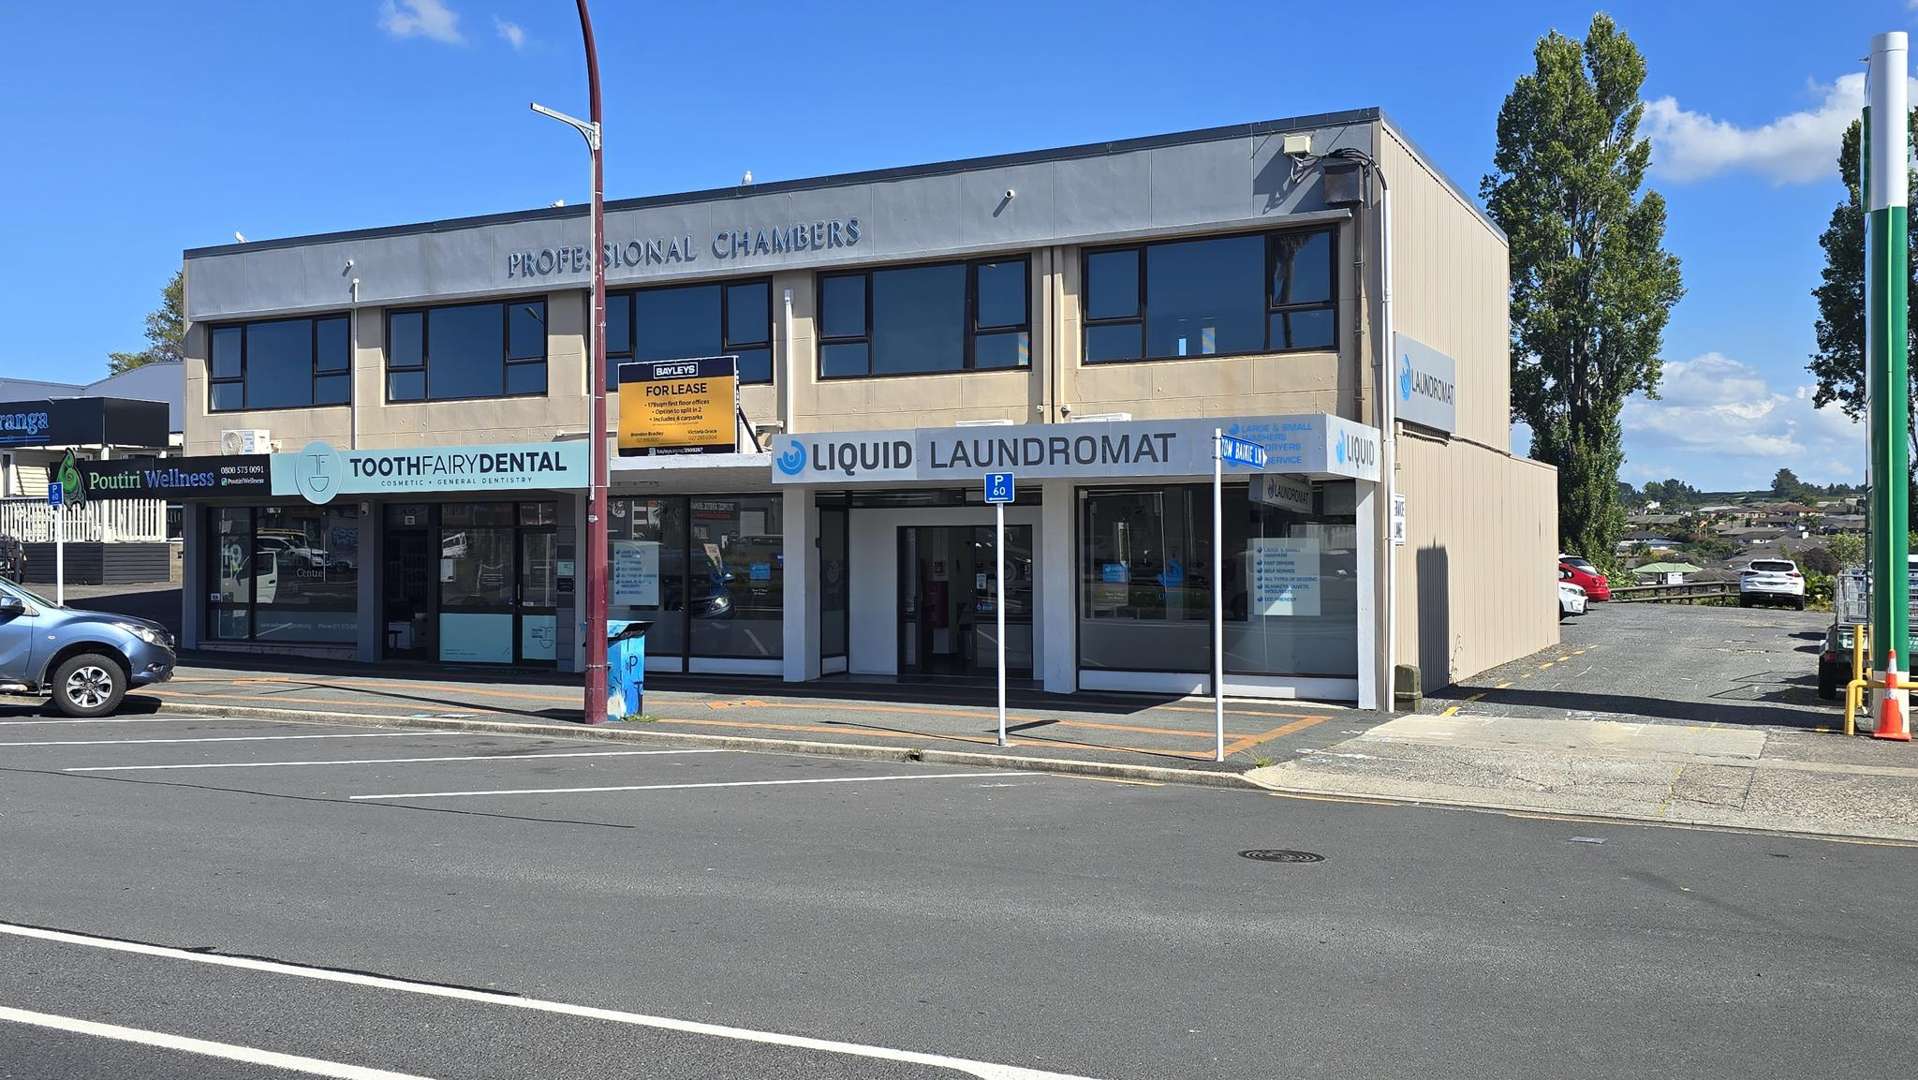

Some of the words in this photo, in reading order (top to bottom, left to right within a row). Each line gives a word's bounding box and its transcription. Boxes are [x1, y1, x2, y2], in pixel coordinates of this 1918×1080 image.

[712, 217, 863, 260] CHAMBERS
[655, 365, 696, 376] BAYLEYS
[646, 385, 669, 397] FOR
[671, 383, 708, 395] LEASE
[1411, 369, 1454, 406] LAUNDROMAT
[812, 440, 912, 476] LIQUID
[930, 432, 1176, 469] LAUNDROMAT
[1346, 434, 1375, 469] LIQUID
[220, 466, 236, 474] 0800
[90, 470, 141, 490] Poutiri
[144, 468, 215, 488] Wellness
[482, 477, 532, 485] DENTISTRY
[994, 475, 1004, 487] P
[52, 484, 58, 493] P
[993, 486, 1006, 496] 60
